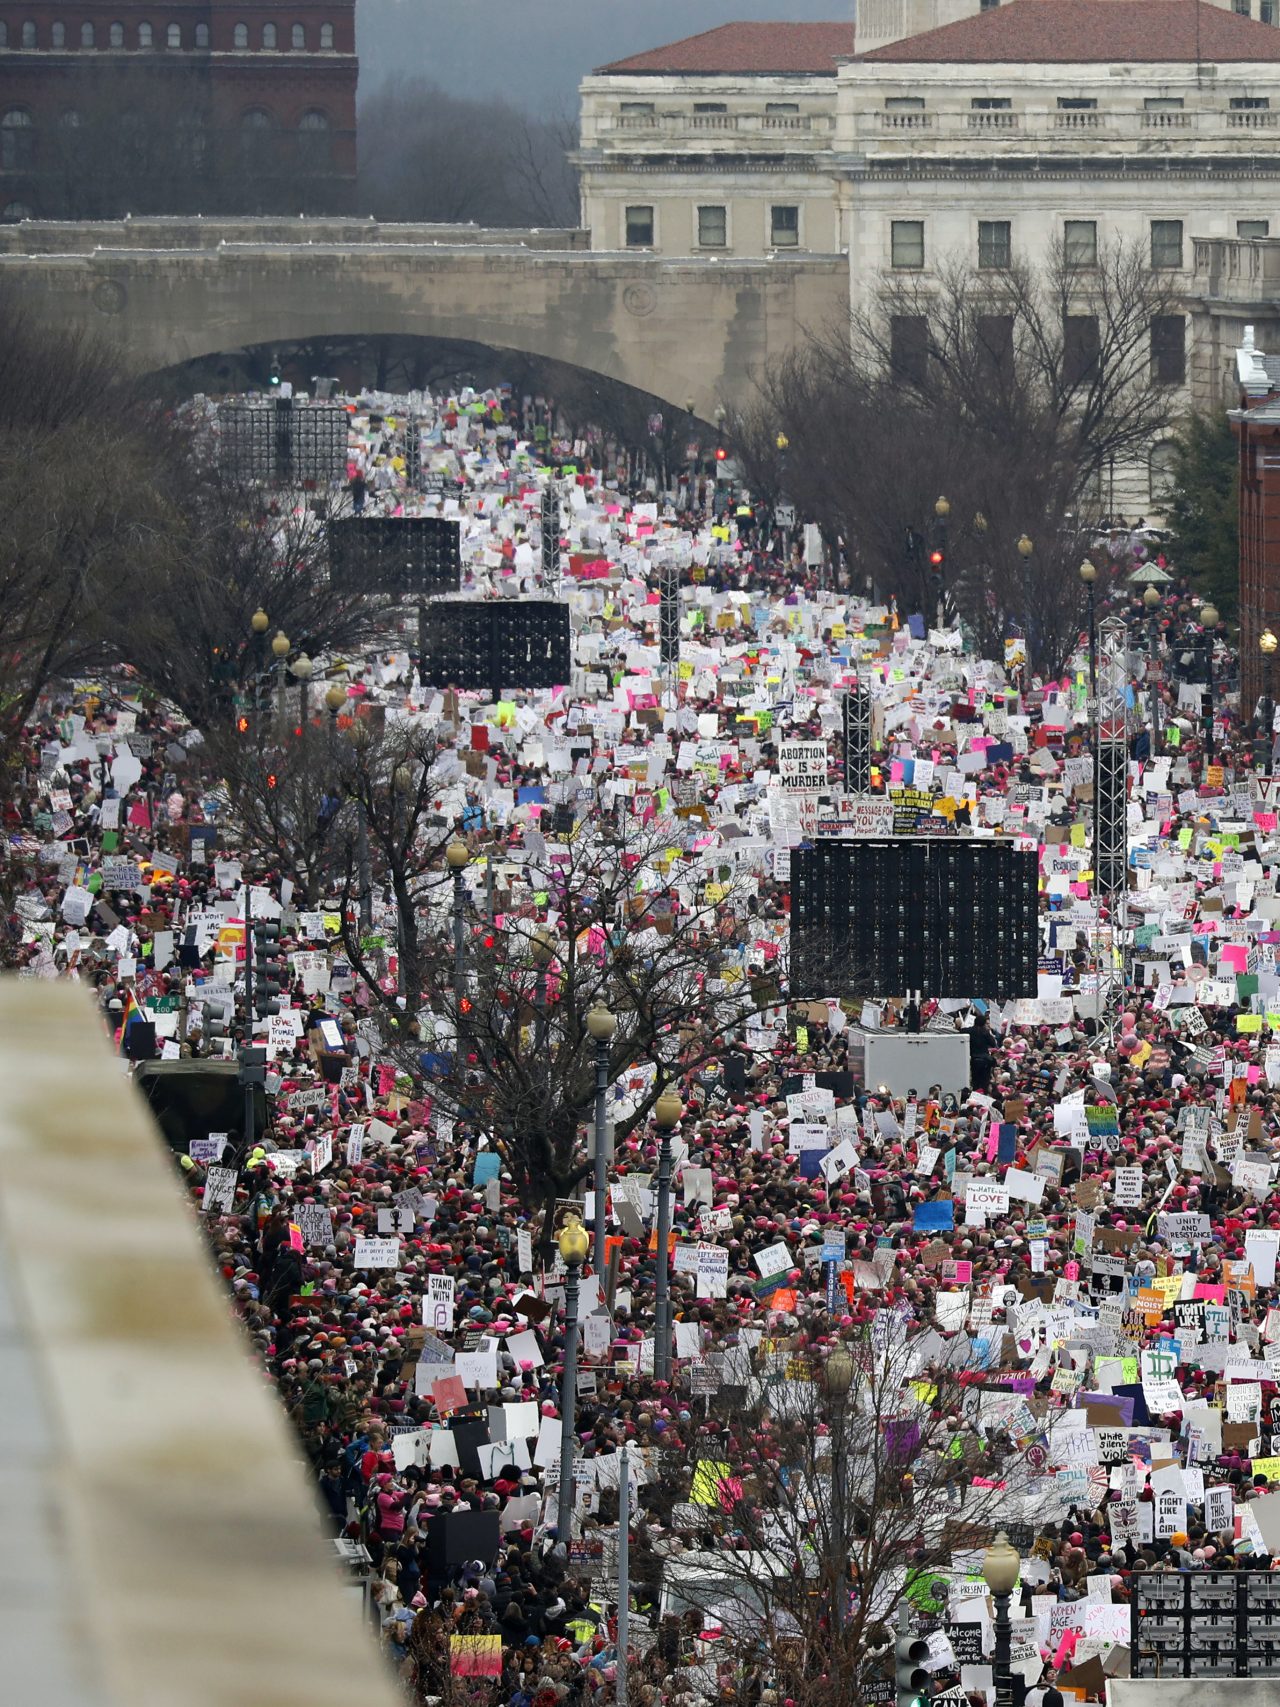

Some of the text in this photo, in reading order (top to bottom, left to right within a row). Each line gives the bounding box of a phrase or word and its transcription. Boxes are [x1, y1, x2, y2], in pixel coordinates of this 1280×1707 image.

[696, 748, 719, 761] Sad!
[780, 748, 825, 760] ABORTION
[798, 762, 808, 774] IS
[781, 774, 826, 787] MURDER
[857, 816, 873, 826] YOU
[156, 998, 162, 1006] 7
[973, 1194, 1004, 1204] LOVE
[1094, 1256, 1124, 1265] RESISTANCE
[698, 1265, 727, 1274] FORWARD
[431, 1278, 452, 1290] STAND
[433, 1290, 450, 1302] WITH
[1136, 1300, 1162, 1309] NOISY
[1175, 1306, 1204, 1317] FIGHT
[1206, 1311, 1228, 1322] STILL
[1180, 1318, 1200, 1328] LIKE
[1100, 1432, 1123, 1441] White
[1059, 1471, 1085, 1481] STILL
[1210, 1493, 1222, 1504] NOT
[1110, 1500, 1136, 1508] POWER
[1210, 1505, 1224, 1515] THIS
[1211, 1517, 1230, 1530] PUSSY
[960, 1585, 989, 1594] PRESENT
[1050, 1604, 1076, 1616] WOMEN
